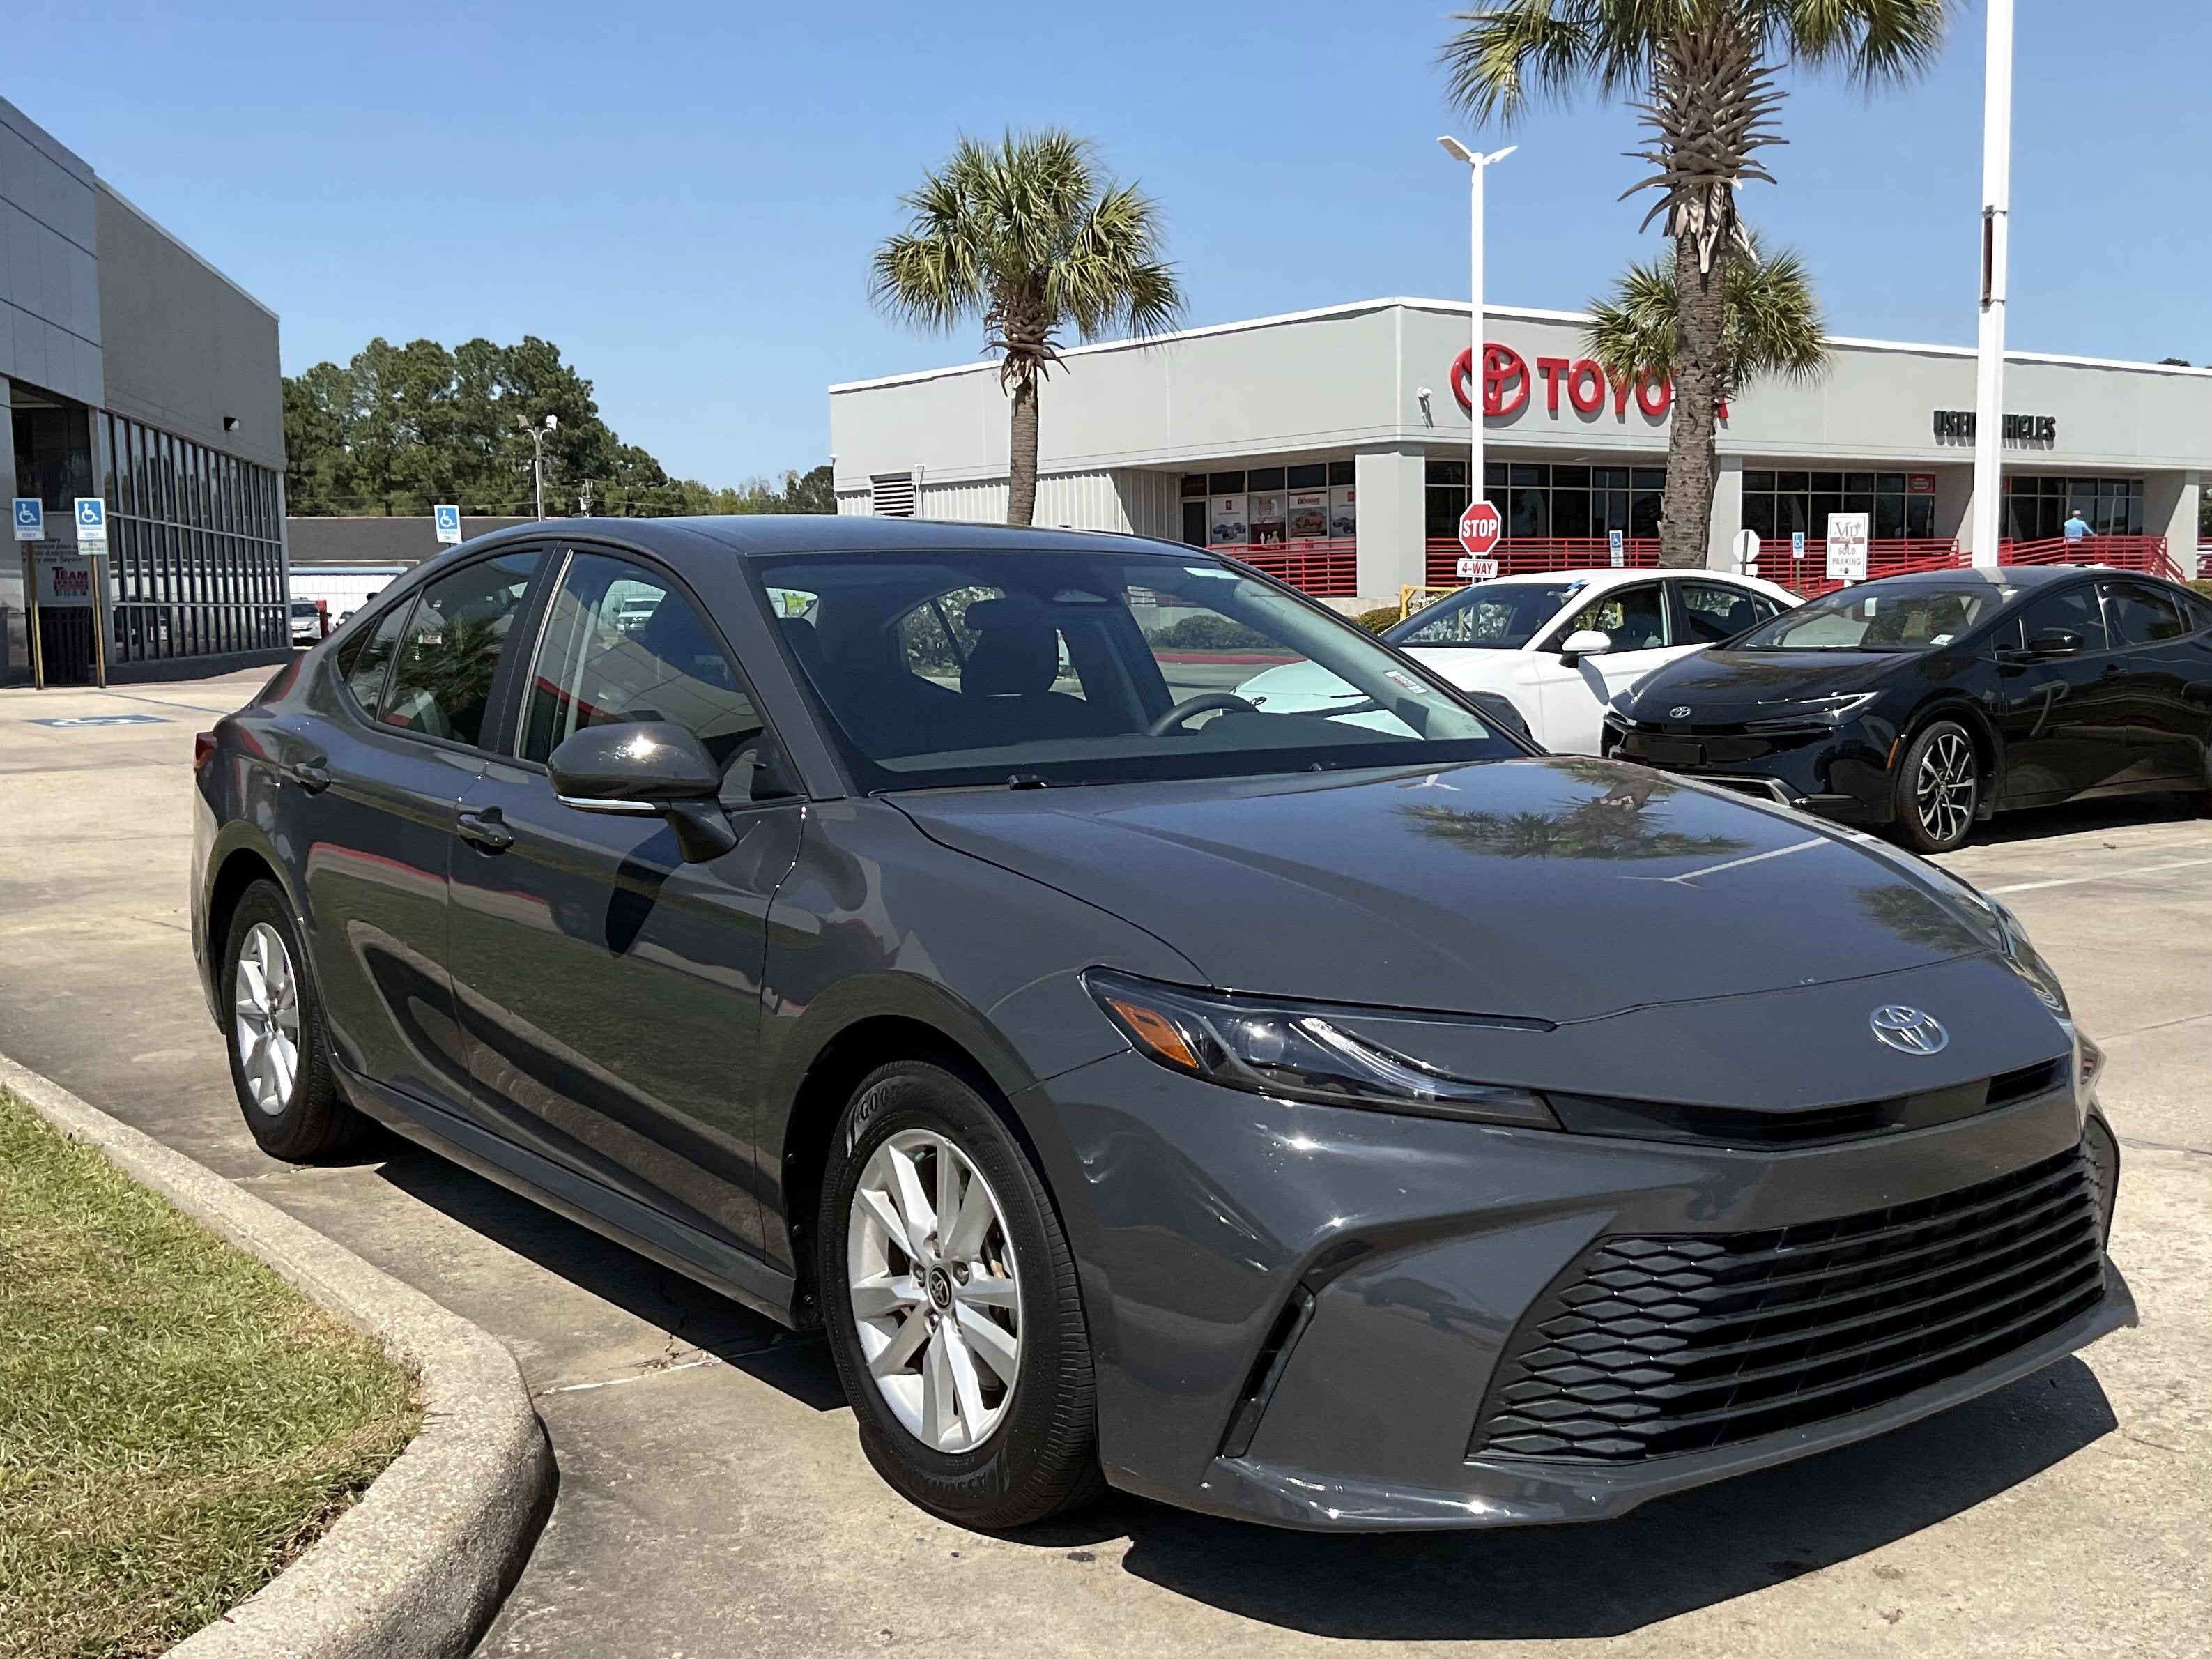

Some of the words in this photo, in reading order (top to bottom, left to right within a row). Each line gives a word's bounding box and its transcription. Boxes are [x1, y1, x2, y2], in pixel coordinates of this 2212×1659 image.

[1537, 357, 1729, 419] TOYO
[1462, 519, 1498, 538] STOP
[1461, 563, 1493, 574] 4-WAY
[1831, 558, 1861, 566] PARKING
[52, 567, 88, 580] TEAM
